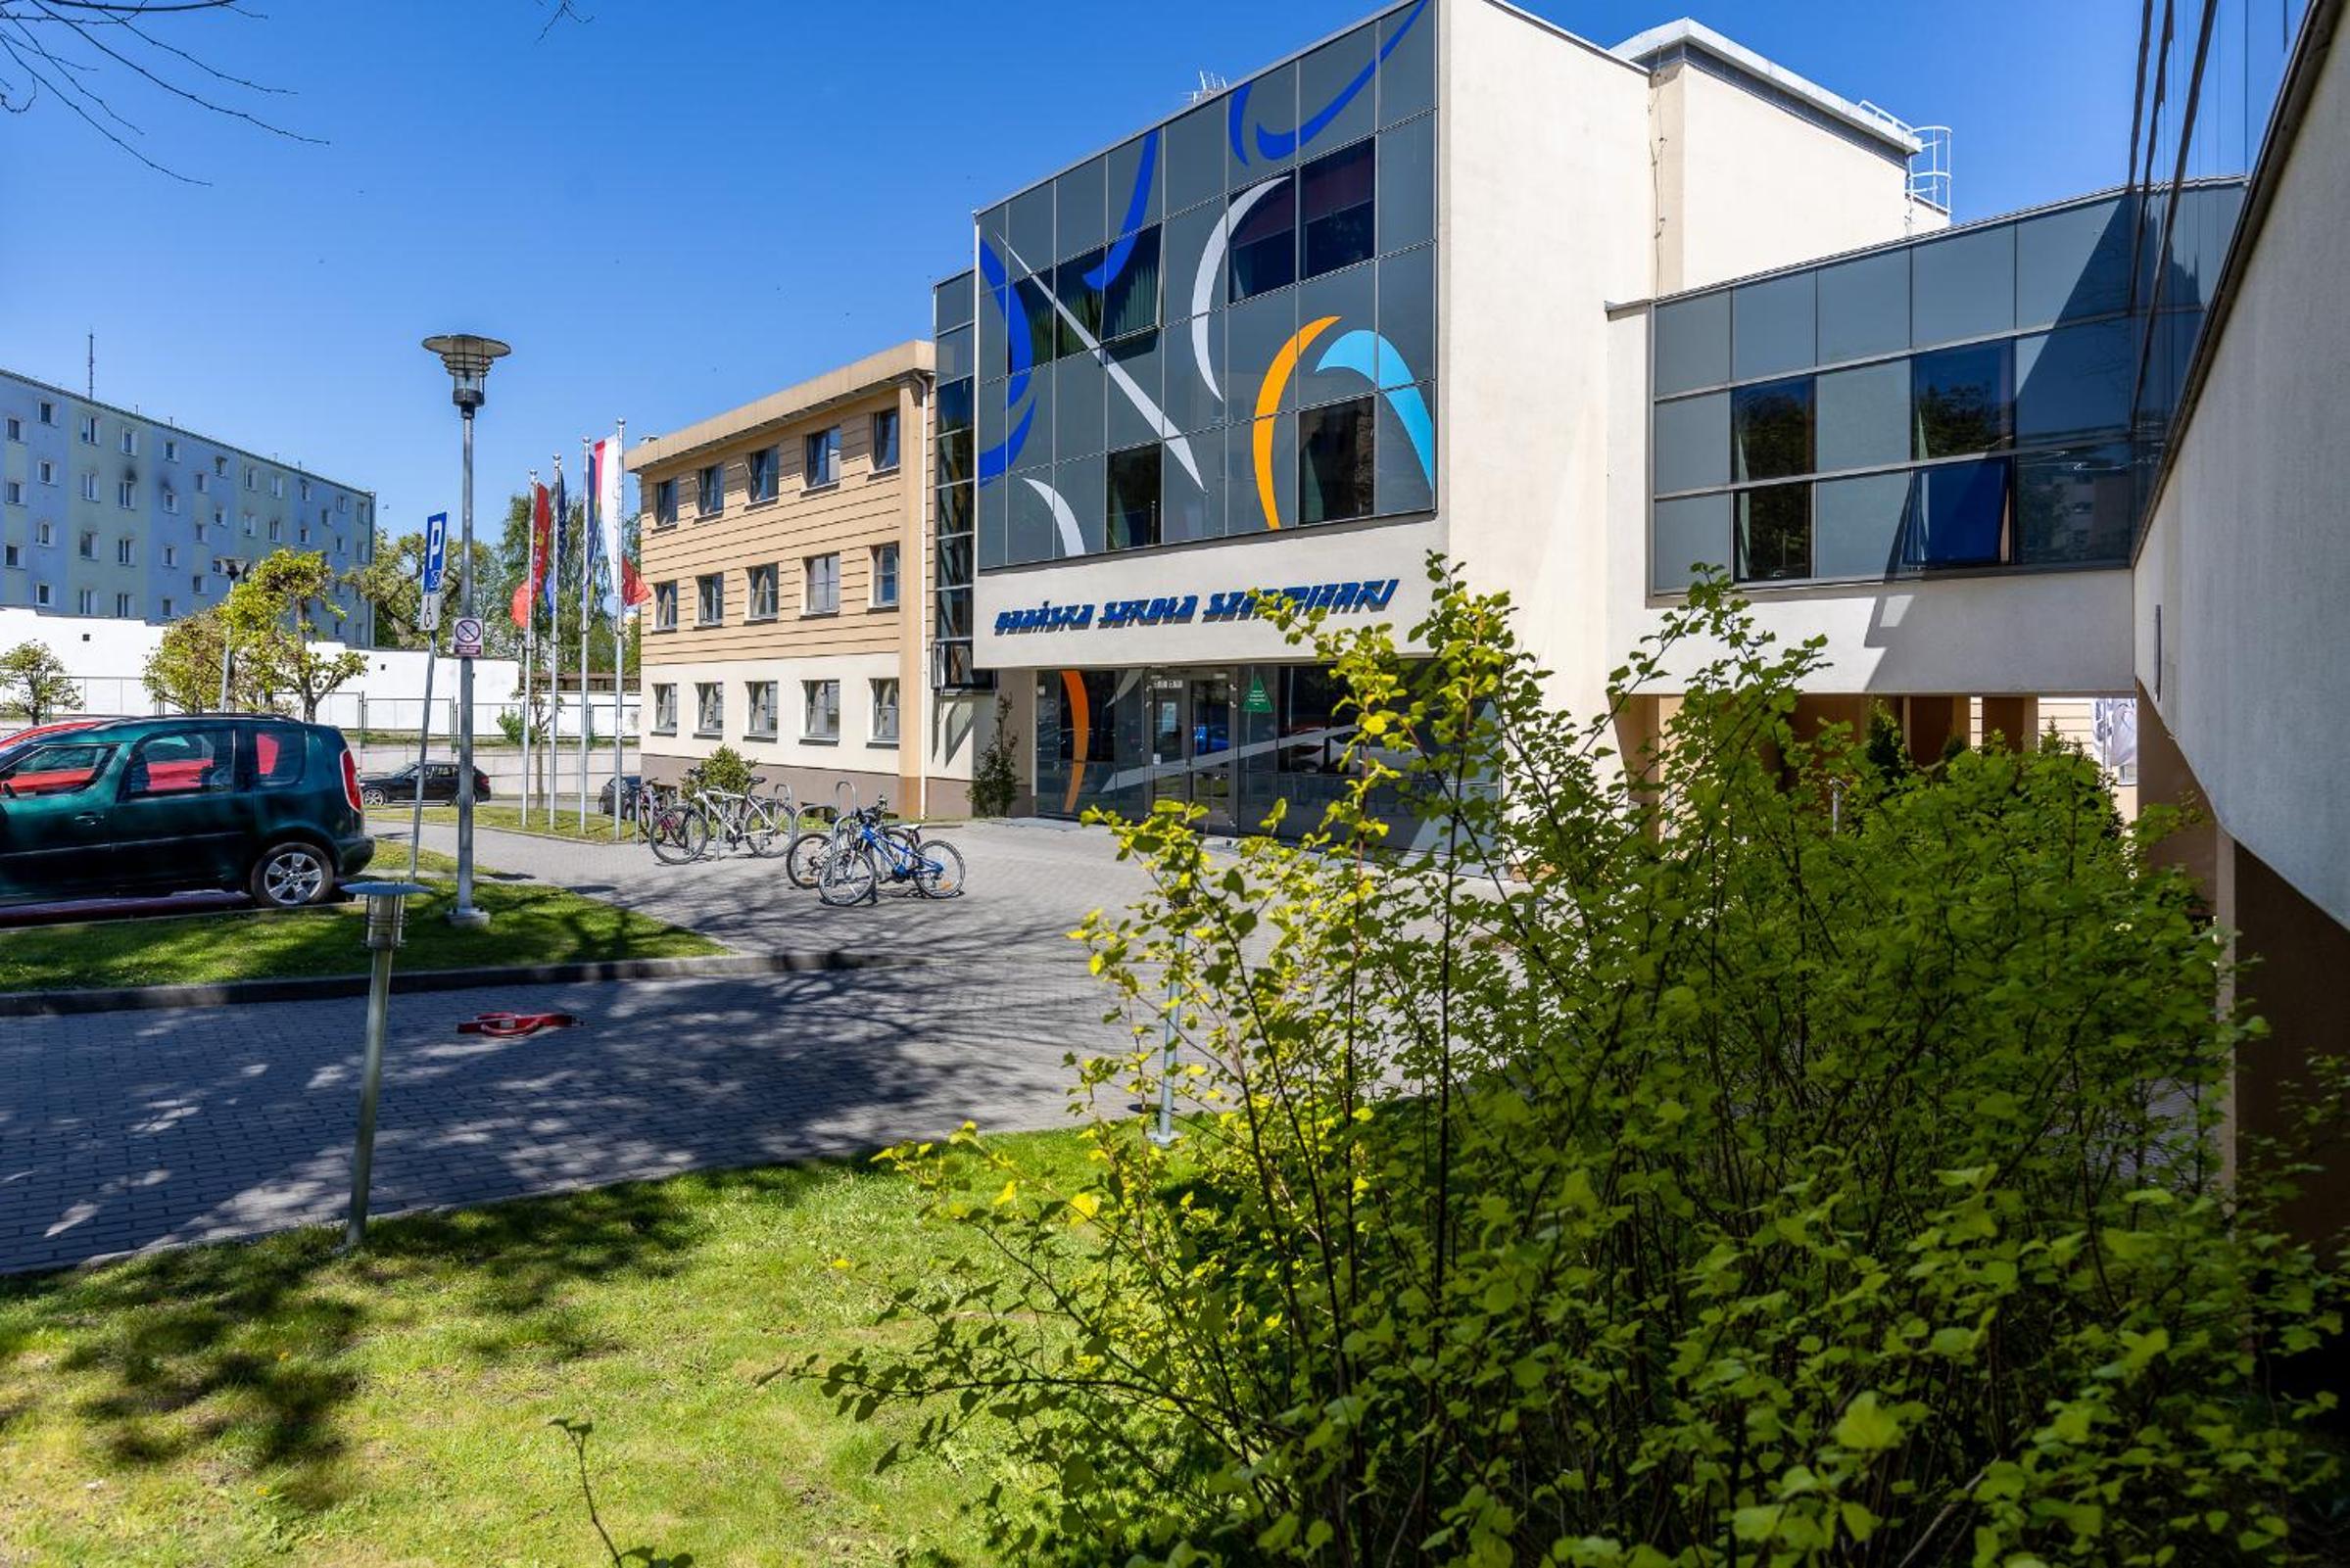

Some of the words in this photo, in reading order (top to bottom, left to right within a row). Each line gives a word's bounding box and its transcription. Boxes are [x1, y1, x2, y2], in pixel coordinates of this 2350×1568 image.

[429, 520, 443, 570] P
[994, 600, 1095, 633] GDAŃSKA
[1097, 595, 1199, 627] SZKOŁA
